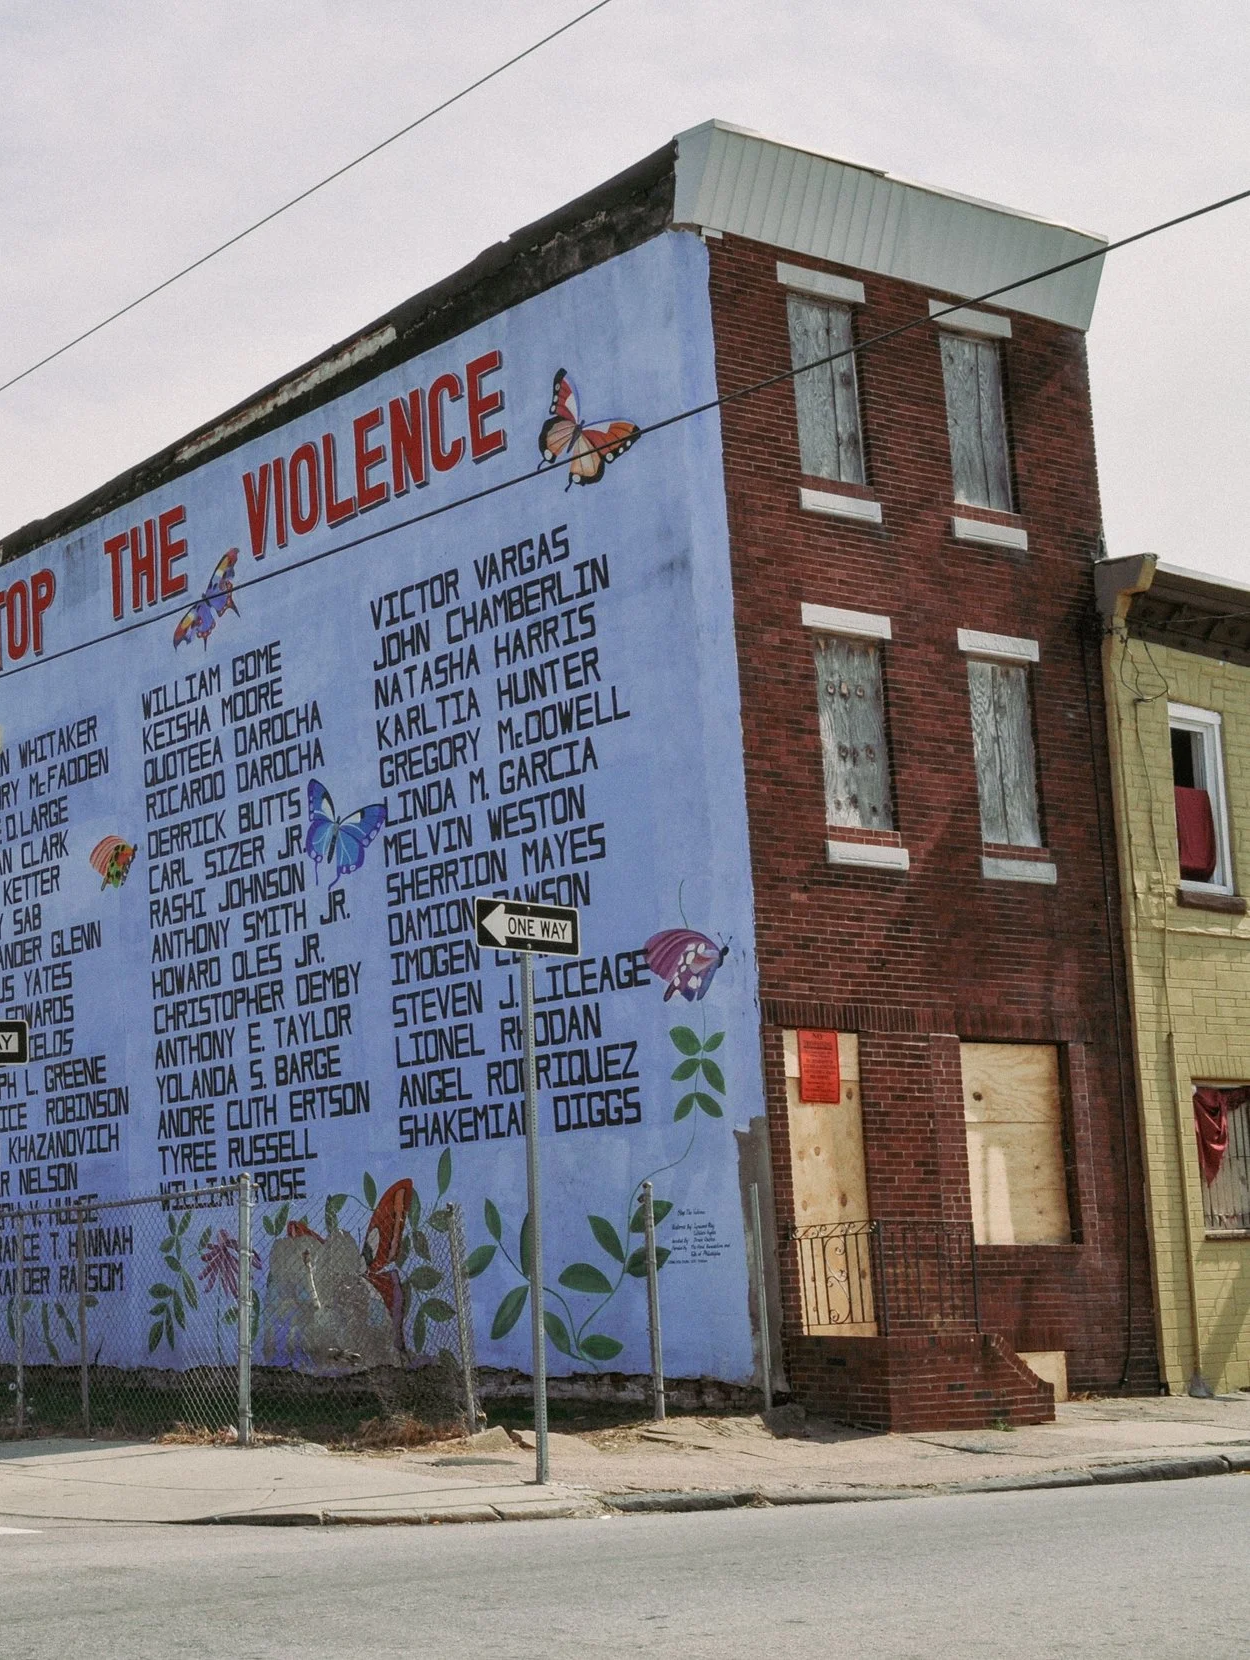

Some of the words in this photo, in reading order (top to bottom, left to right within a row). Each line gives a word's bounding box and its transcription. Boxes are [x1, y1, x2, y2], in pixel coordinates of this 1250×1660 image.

[103, 505, 188, 621] THE
[242, 350, 507, 561] VIOLENCE
[370, 568, 460, 630] VICTOR
[473, 523, 570, 590] VARGAS
[373, 620, 430, 671] JOHN
[446, 554, 610, 644] CHAMBERLIN
[142, 664, 221, 720] WILLIAM
[232, 640, 282, 686] GOME
[374, 644, 480, 709] NATASHA
[494, 601, 596, 668] HARRIS
[142, 705, 211, 754] KEISHA
[221, 677, 283, 726] MOORE
[376, 687, 481, 750] KARLTIA
[497, 646, 601, 711] HUNTER
[18, 715, 97, 769] WHITAKER
[144, 736, 223, 788] QUOTEEA
[234, 700, 323, 757] DAROCHA
[379, 727, 480, 788] GREGORY
[498, 686, 630, 753] McDOWELL
[29, 747, 109, 799] McFADDEN
[146, 770, 225, 822] RICARDO
[236, 738, 325, 793] DAROCHA
[384, 777, 457, 827] LINDA
[469, 767, 489, 804] M.
[499, 736, 598, 795] GARCIA
[21, 829, 69, 869] CLARK
[148, 809, 226, 860] DERRICK
[238, 787, 300, 834] BUTTS
[383, 814, 473, 867] MELVIN
[487, 784, 585, 841] WESTON
[3, 865, 60, 907] KETTER
[149, 858, 193, 894] CARL
[205, 835, 265, 880] SIZER
[278, 824, 306, 860] JR.
[387, 849, 507, 907] SHERRION
[522, 823, 606, 876] MAYES
[13, 903, 42, 936] SAB
[150, 888, 206, 929] RASHI
[219, 861, 305, 912] JOHNSON
[388, 896, 475, 946] DAMION
[51, 920, 101, 959] GLENN
[152, 918, 230, 963] ANTHONY
[243, 899, 307, 943] SMITH
[320, 889, 350, 925] JR.
[508, 917, 535, 937] ONE
[540, 921, 567, 940] WAY
[24, 961, 73, 997] YATES
[152, 956, 221, 1000] HOWARD
[232, 942, 282, 982] OLES
[295, 933, 325, 968] JR.
[391, 939, 480, 985] IMOGEN
[154, 979, 285, 1035] CHRISTOPHER
[296, 961, 361, 1006] DEMBY
[393, 980, 483, 1027] STEVEN
[499, 974, 519, 1009] J.
[155, 1026, 235, 1069] ANTHONY
[248, 1022, 265, 1054] E.
[273, 1004, 352, 1048] TAYLOR
[395, 1023, 485, 1068] LIONEL
[25, 1069, 38, 1096] L.
[44, 1055, 106, 1093] GREENE
[157, 1064, 238, 1104] YOLANDA
[250, 1059, 267, 1091] S.
[274, 1044, 341, 1087] BARGE
[399, 1067, 472, 1108] ANGEL
[46, 1086, 129, 1126] ROBINSON
[158, 1104, 215, 1140] ANDRE
[227, 1094, 277, 1131] CUTH
[289, 1080, 370, 1123] ERTSON
[553, 1086, 641, 1132] DIGGS
[9, 1123, 119, 1164] KHAZANOVICH
[158, 1140, 217, 1175] TYREE
[228, 1128, 318, 1168] RUSSELL
[19, 1163, 78, 1195] NELSON
[254, 1167, 306, 1203] ROSE
[50, 1232, 61, 1260] T.
[60, 1262, 123, 1293] RASOM
